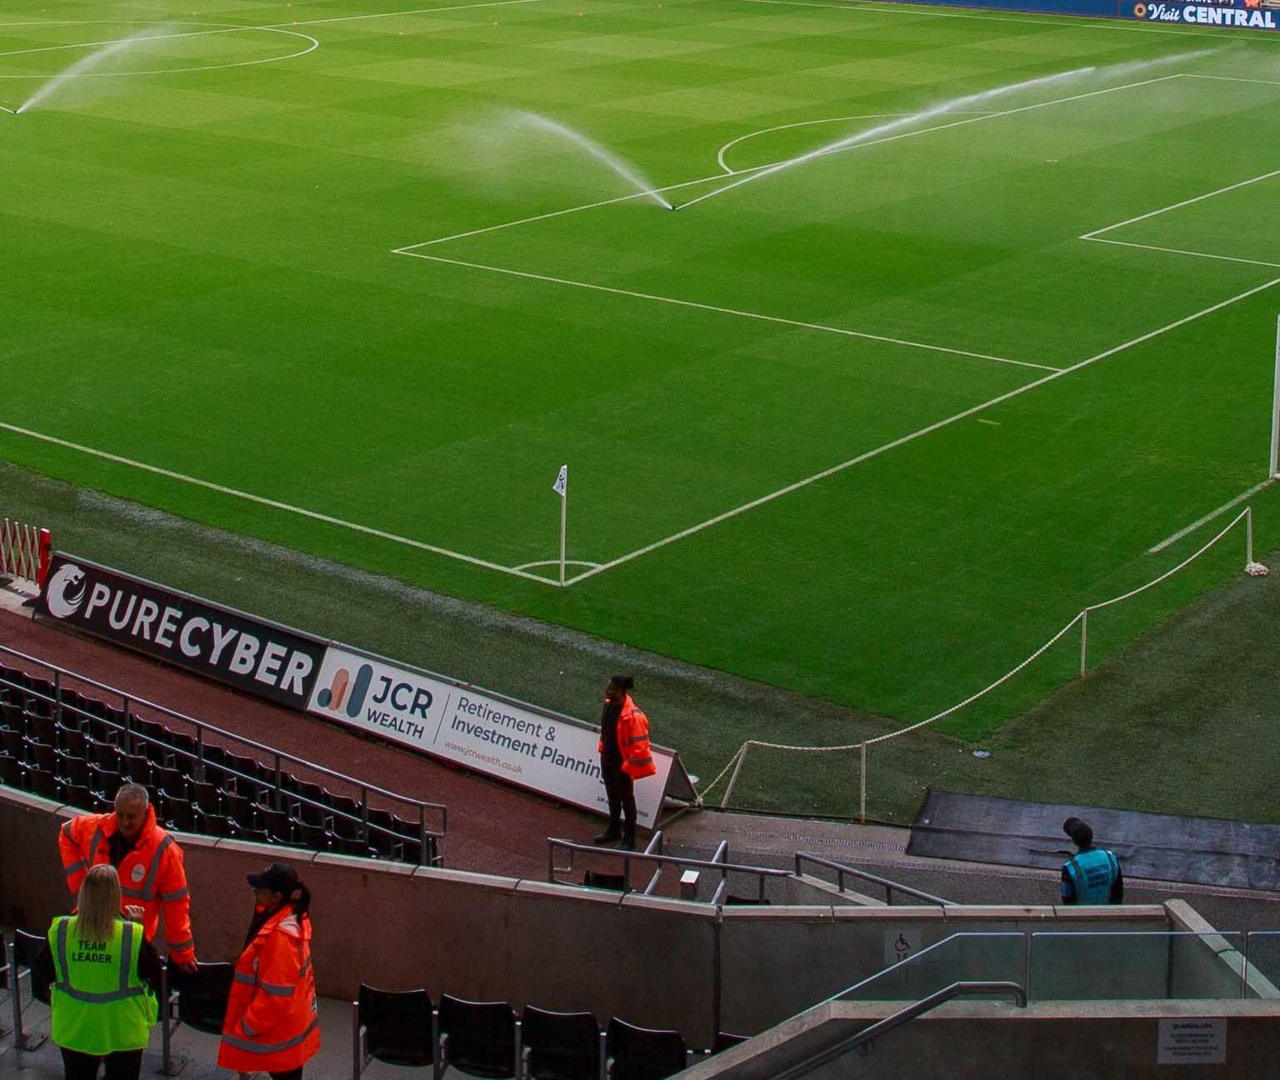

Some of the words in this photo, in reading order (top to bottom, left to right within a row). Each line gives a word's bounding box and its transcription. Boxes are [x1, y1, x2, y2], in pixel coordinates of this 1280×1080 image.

[1147, 3, 1180, 21] Visit
[1183, 6, 1276, 30] CENTRAL
[85, 581, 315, 697] PURECYBER
[372, 675, 434, 720] JCR
[366, 707, 425, 740] WEALTH
[456, 696, 542, 737] Retirement
[544, 726, 557, 742] &
[444, 739, 523, 774] www.jcrwealth.co.uk
[450, 714, 538, 758] Investment
[540, 745, 605, 785] Plannin
[71, 951, 113, 964] LEADER
[77, 939, 107, 952] TEAM
